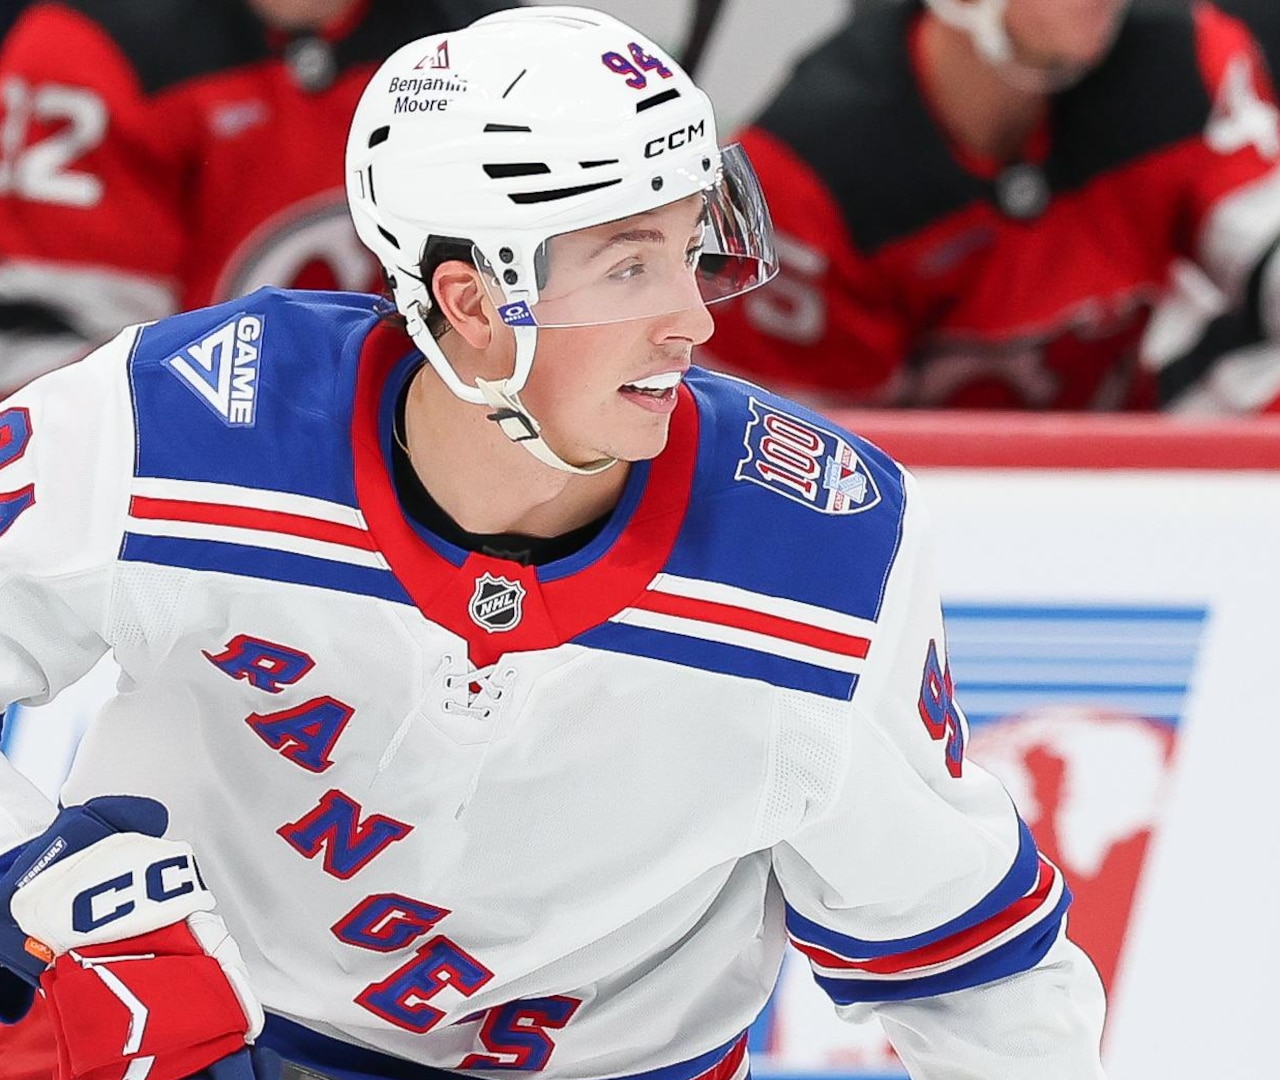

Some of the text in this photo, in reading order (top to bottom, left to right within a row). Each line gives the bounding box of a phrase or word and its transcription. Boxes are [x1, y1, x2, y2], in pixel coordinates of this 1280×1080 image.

[601, 41, 673, 90] 94
[393, 95, 448, 115] Moore
[644, 118, 705, 159] CCM
[228, 316, 261, 424] GAME
[754, 412, 826, 503] 100
[479, 593, 514, 617] NHL
[200, 633, 584, 1074] RANGES
[72, 854, 209, 933] CC
